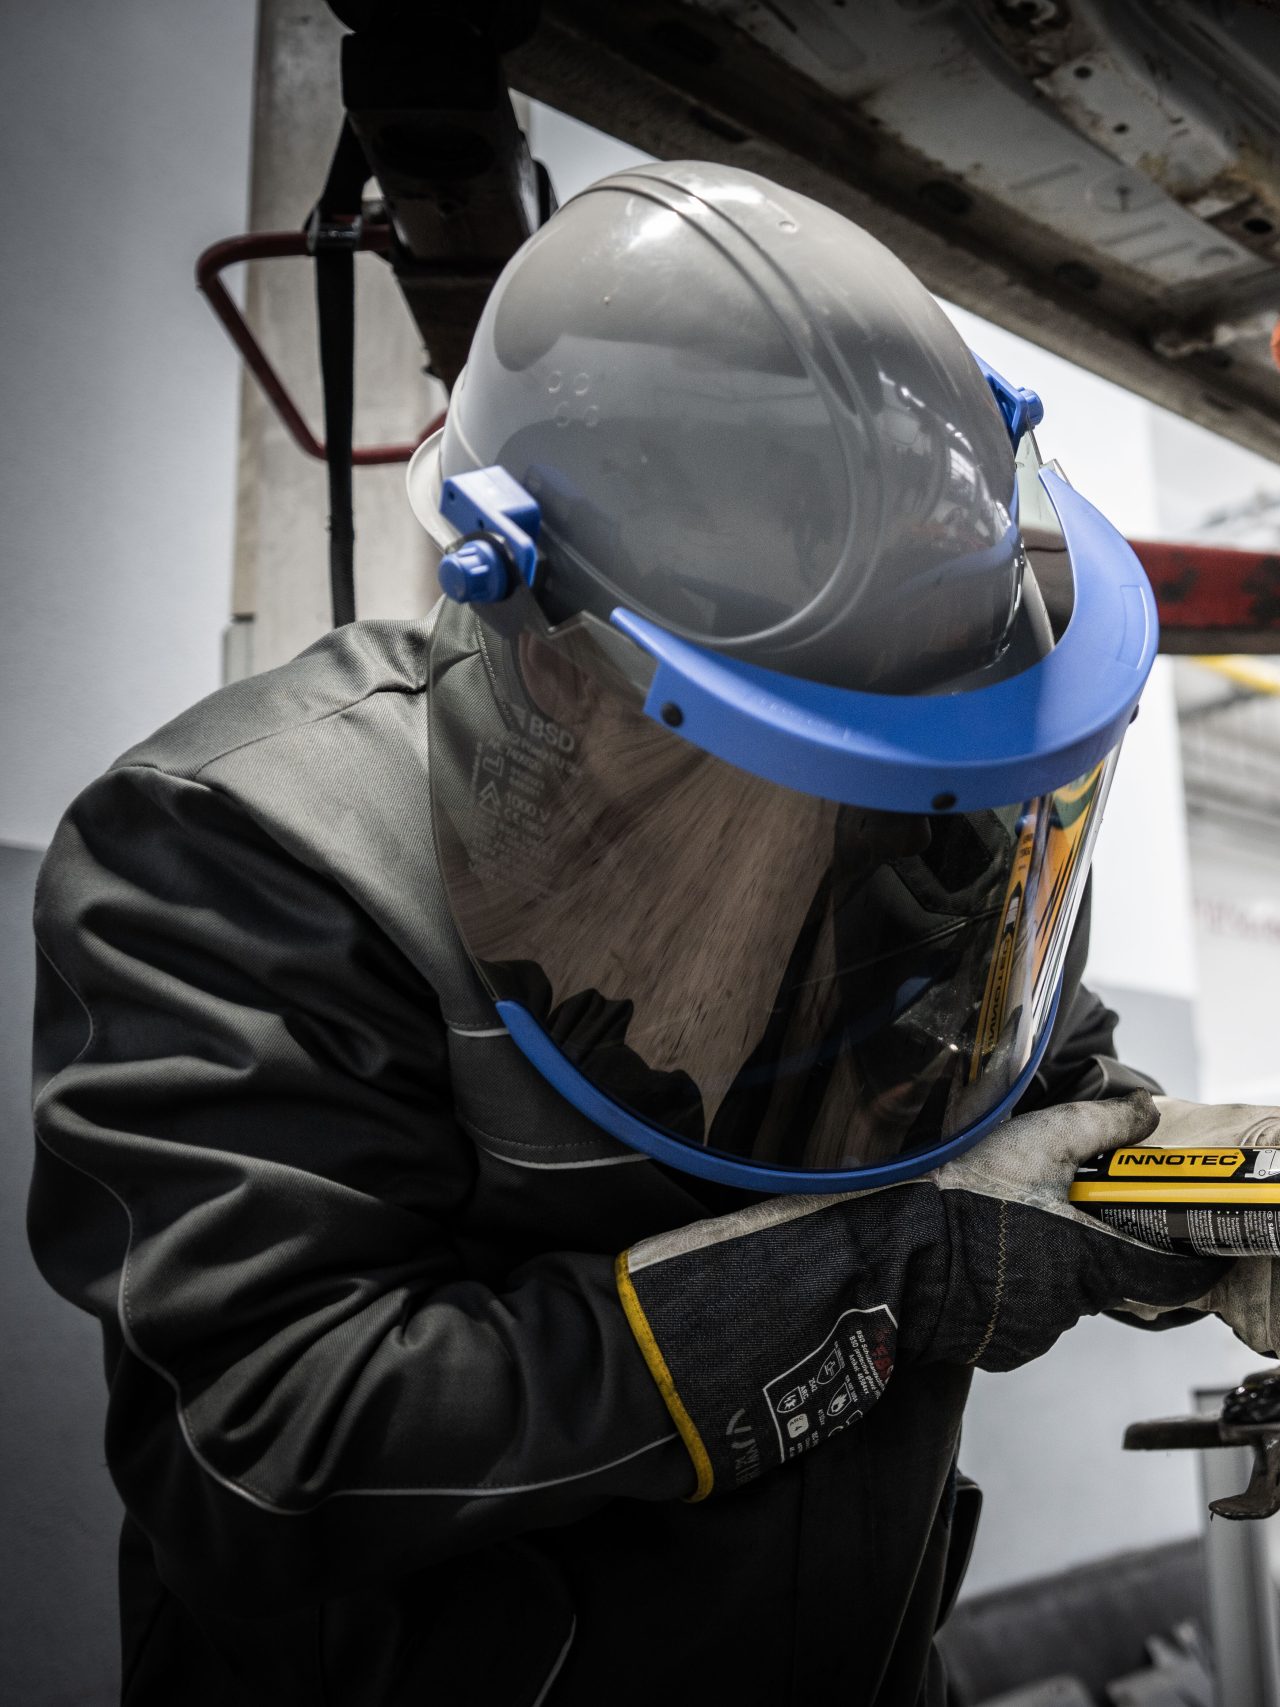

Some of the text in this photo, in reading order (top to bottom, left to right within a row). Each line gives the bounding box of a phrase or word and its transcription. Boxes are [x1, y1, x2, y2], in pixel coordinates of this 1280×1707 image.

[529, 716, 574, 752] BSD
[1117, 1154, 1238, 1166] INNOTEC
[849, 1335, 859, 1348] BSD
[856, 1330, 865, 1343] BSD
